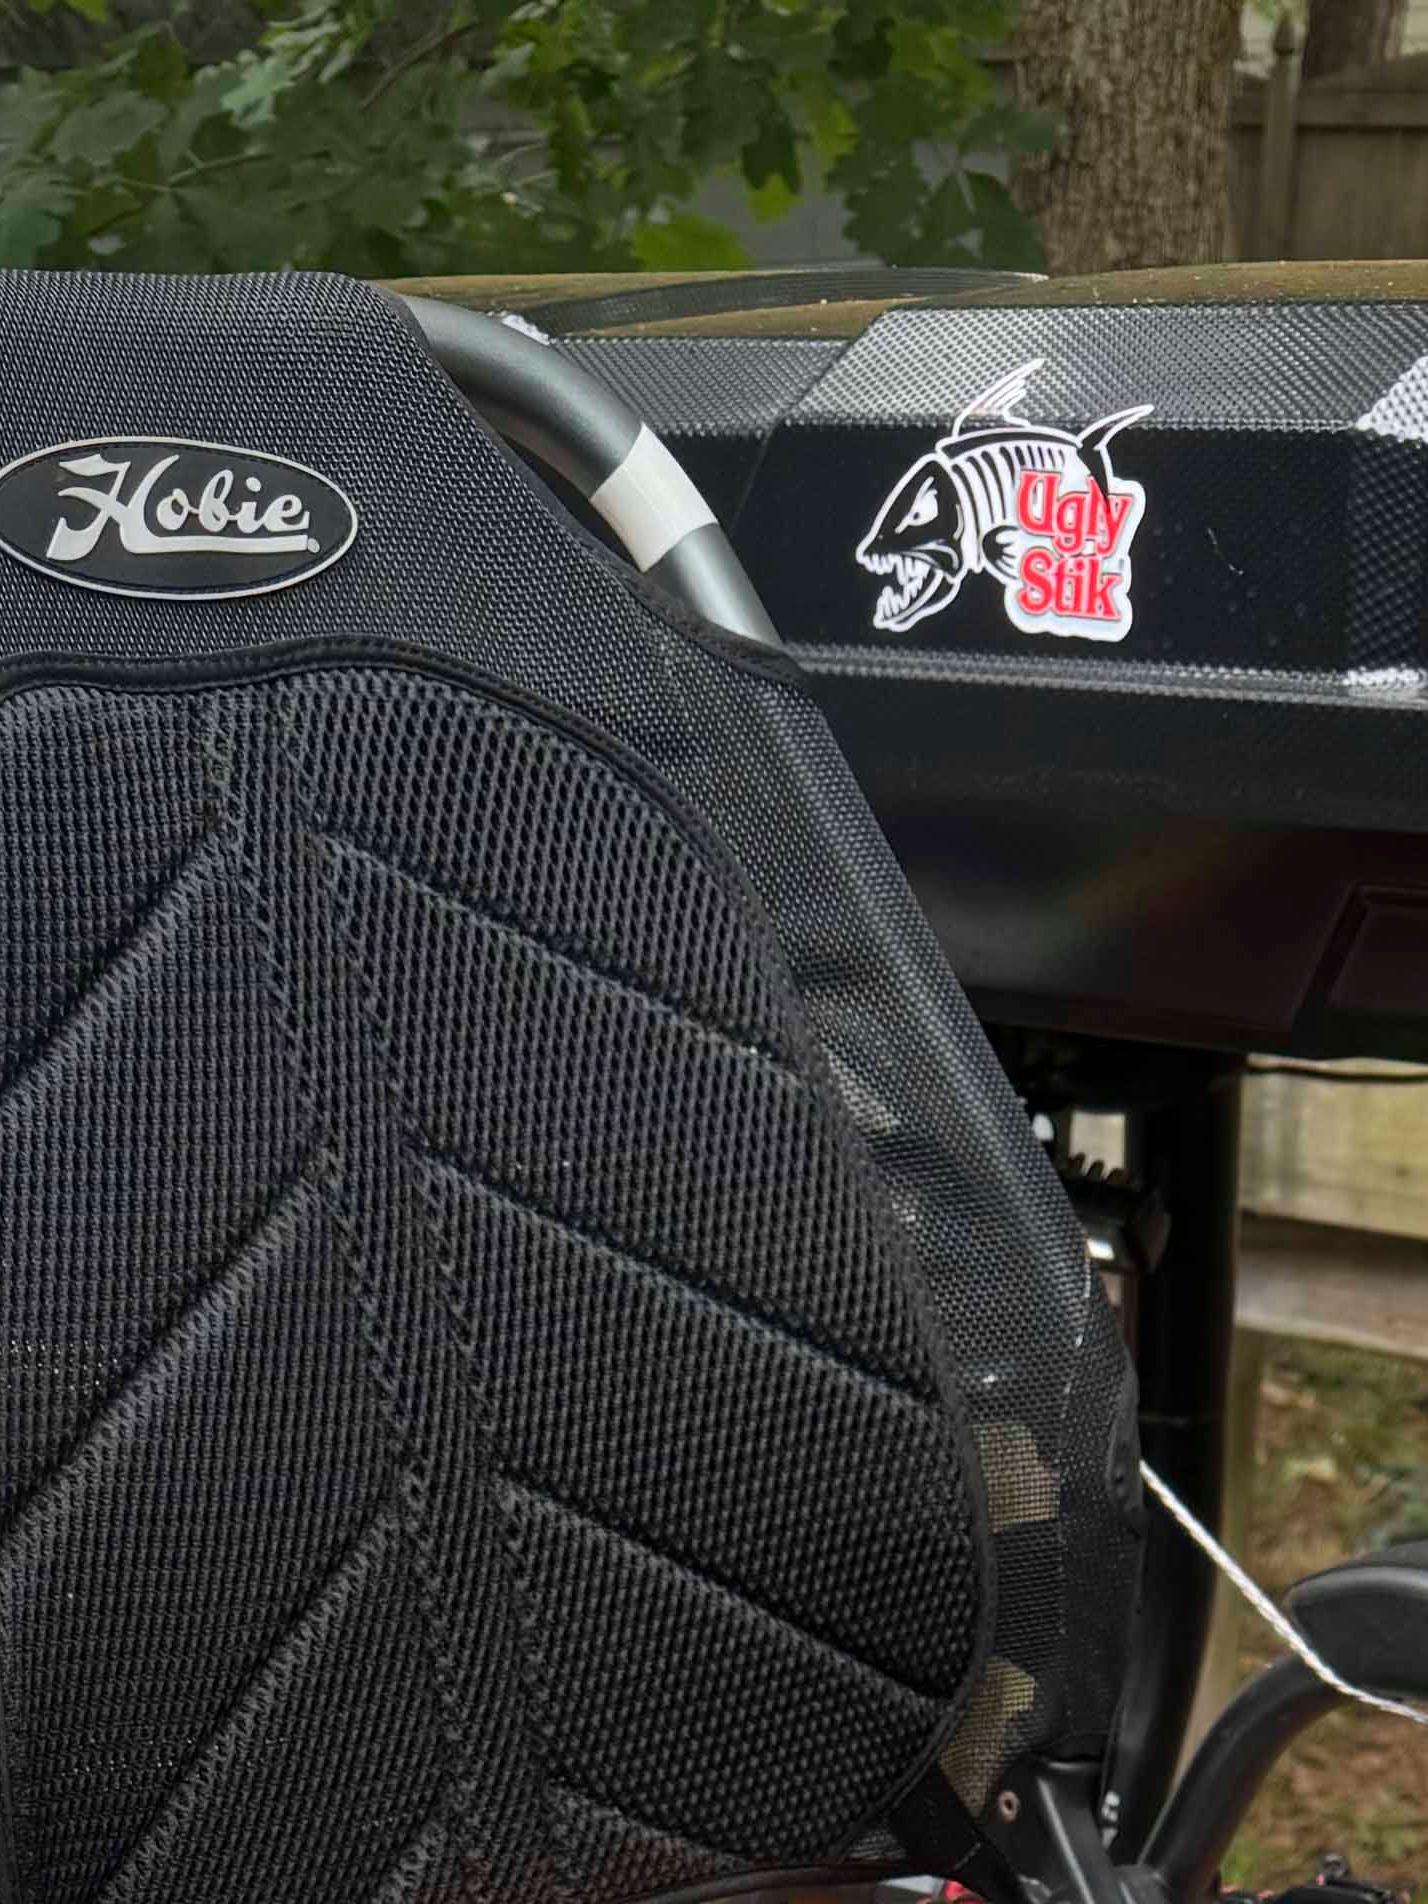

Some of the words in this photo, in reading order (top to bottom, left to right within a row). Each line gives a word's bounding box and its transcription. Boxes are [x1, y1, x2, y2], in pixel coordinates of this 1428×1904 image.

[45, 452, 320, 561] Hobie
[1018, 469, 1132, 554] Ugly
[1018, 547, 1123, 623] Stik
